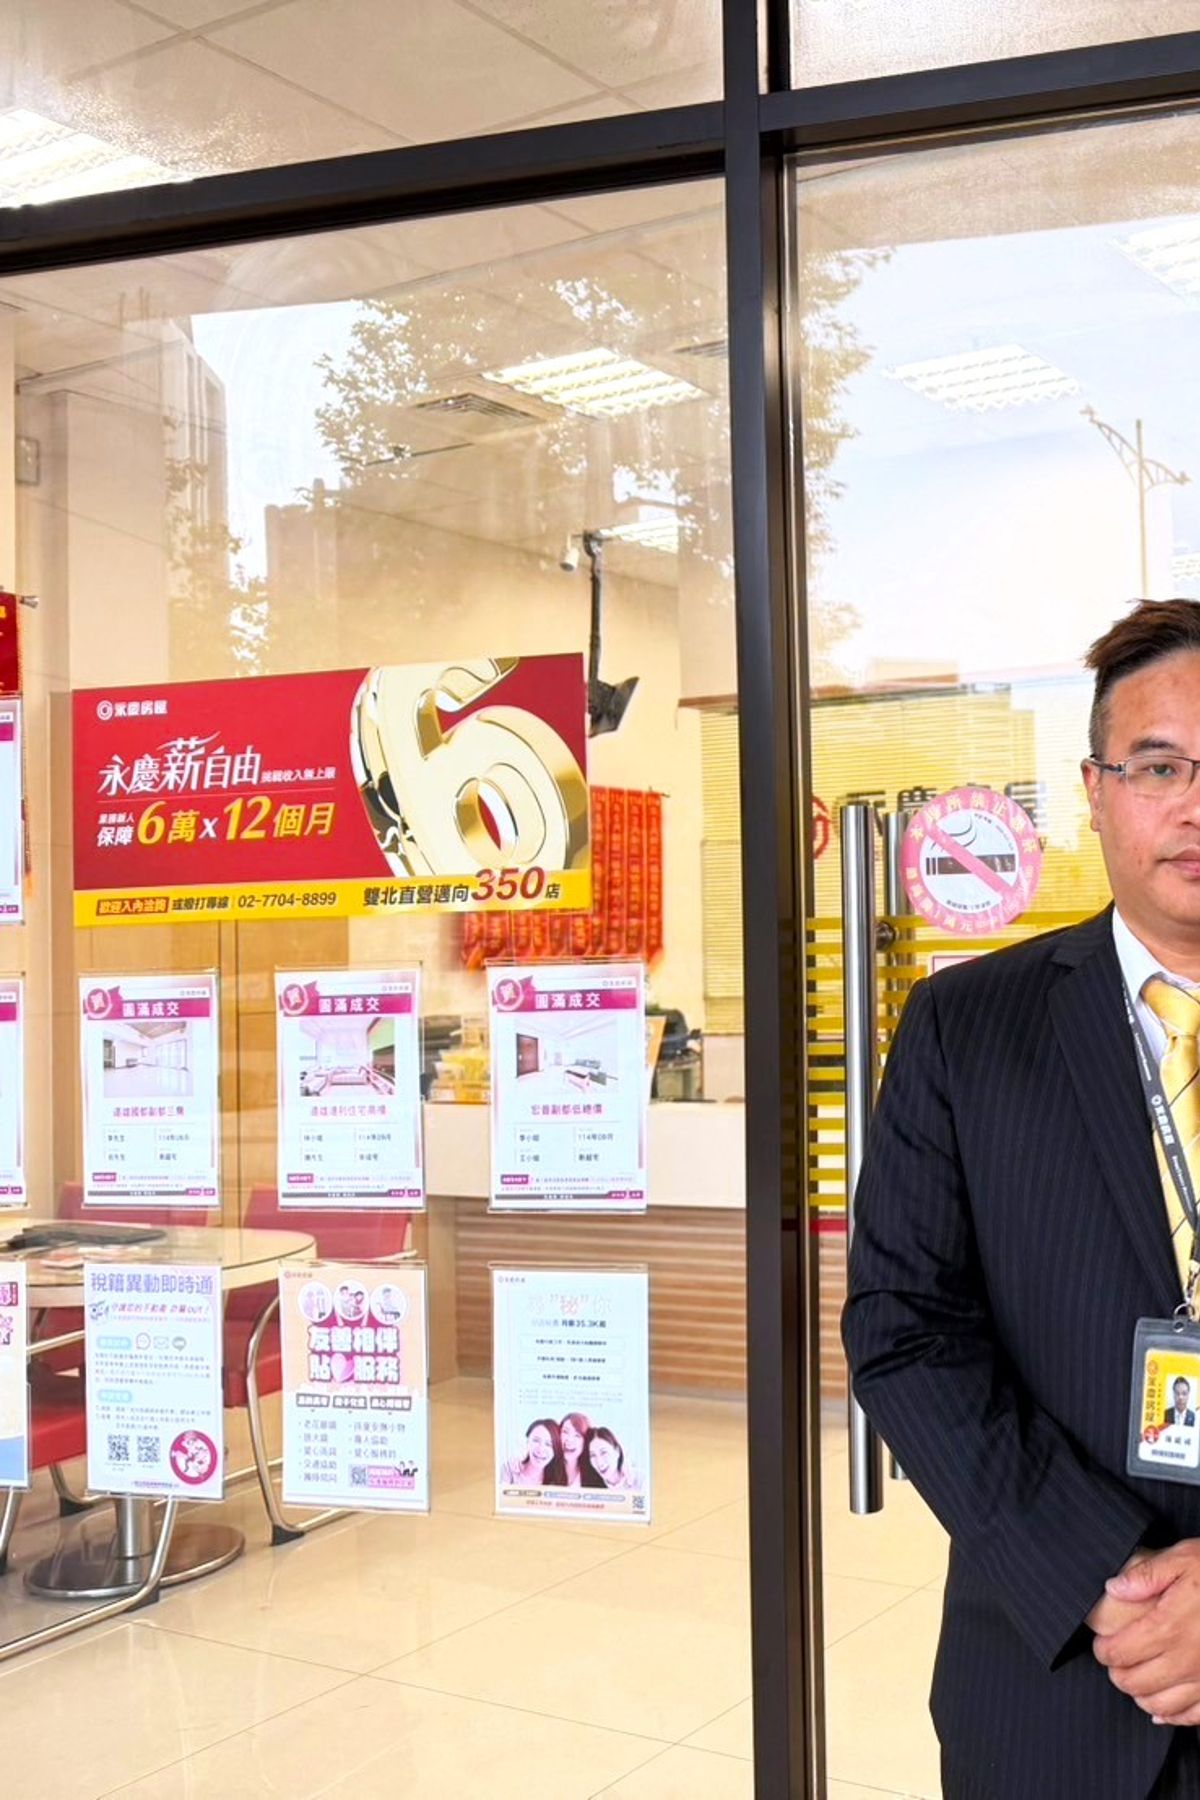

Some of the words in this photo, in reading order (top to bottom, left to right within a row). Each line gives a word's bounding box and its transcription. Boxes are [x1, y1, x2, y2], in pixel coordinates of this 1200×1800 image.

[97, 732, 262, 796] 永慶薪自由
[237, 892, 337, 909] 02-7704-8899
[122, 1001, 180, 1018] 圓滿成交
[318, 997, 381, 1014] 圓滿成交
[535, 993, 601, 1010] 圓滿成交
[91, 1272, 213, 1295] 稅籍異動即時通
